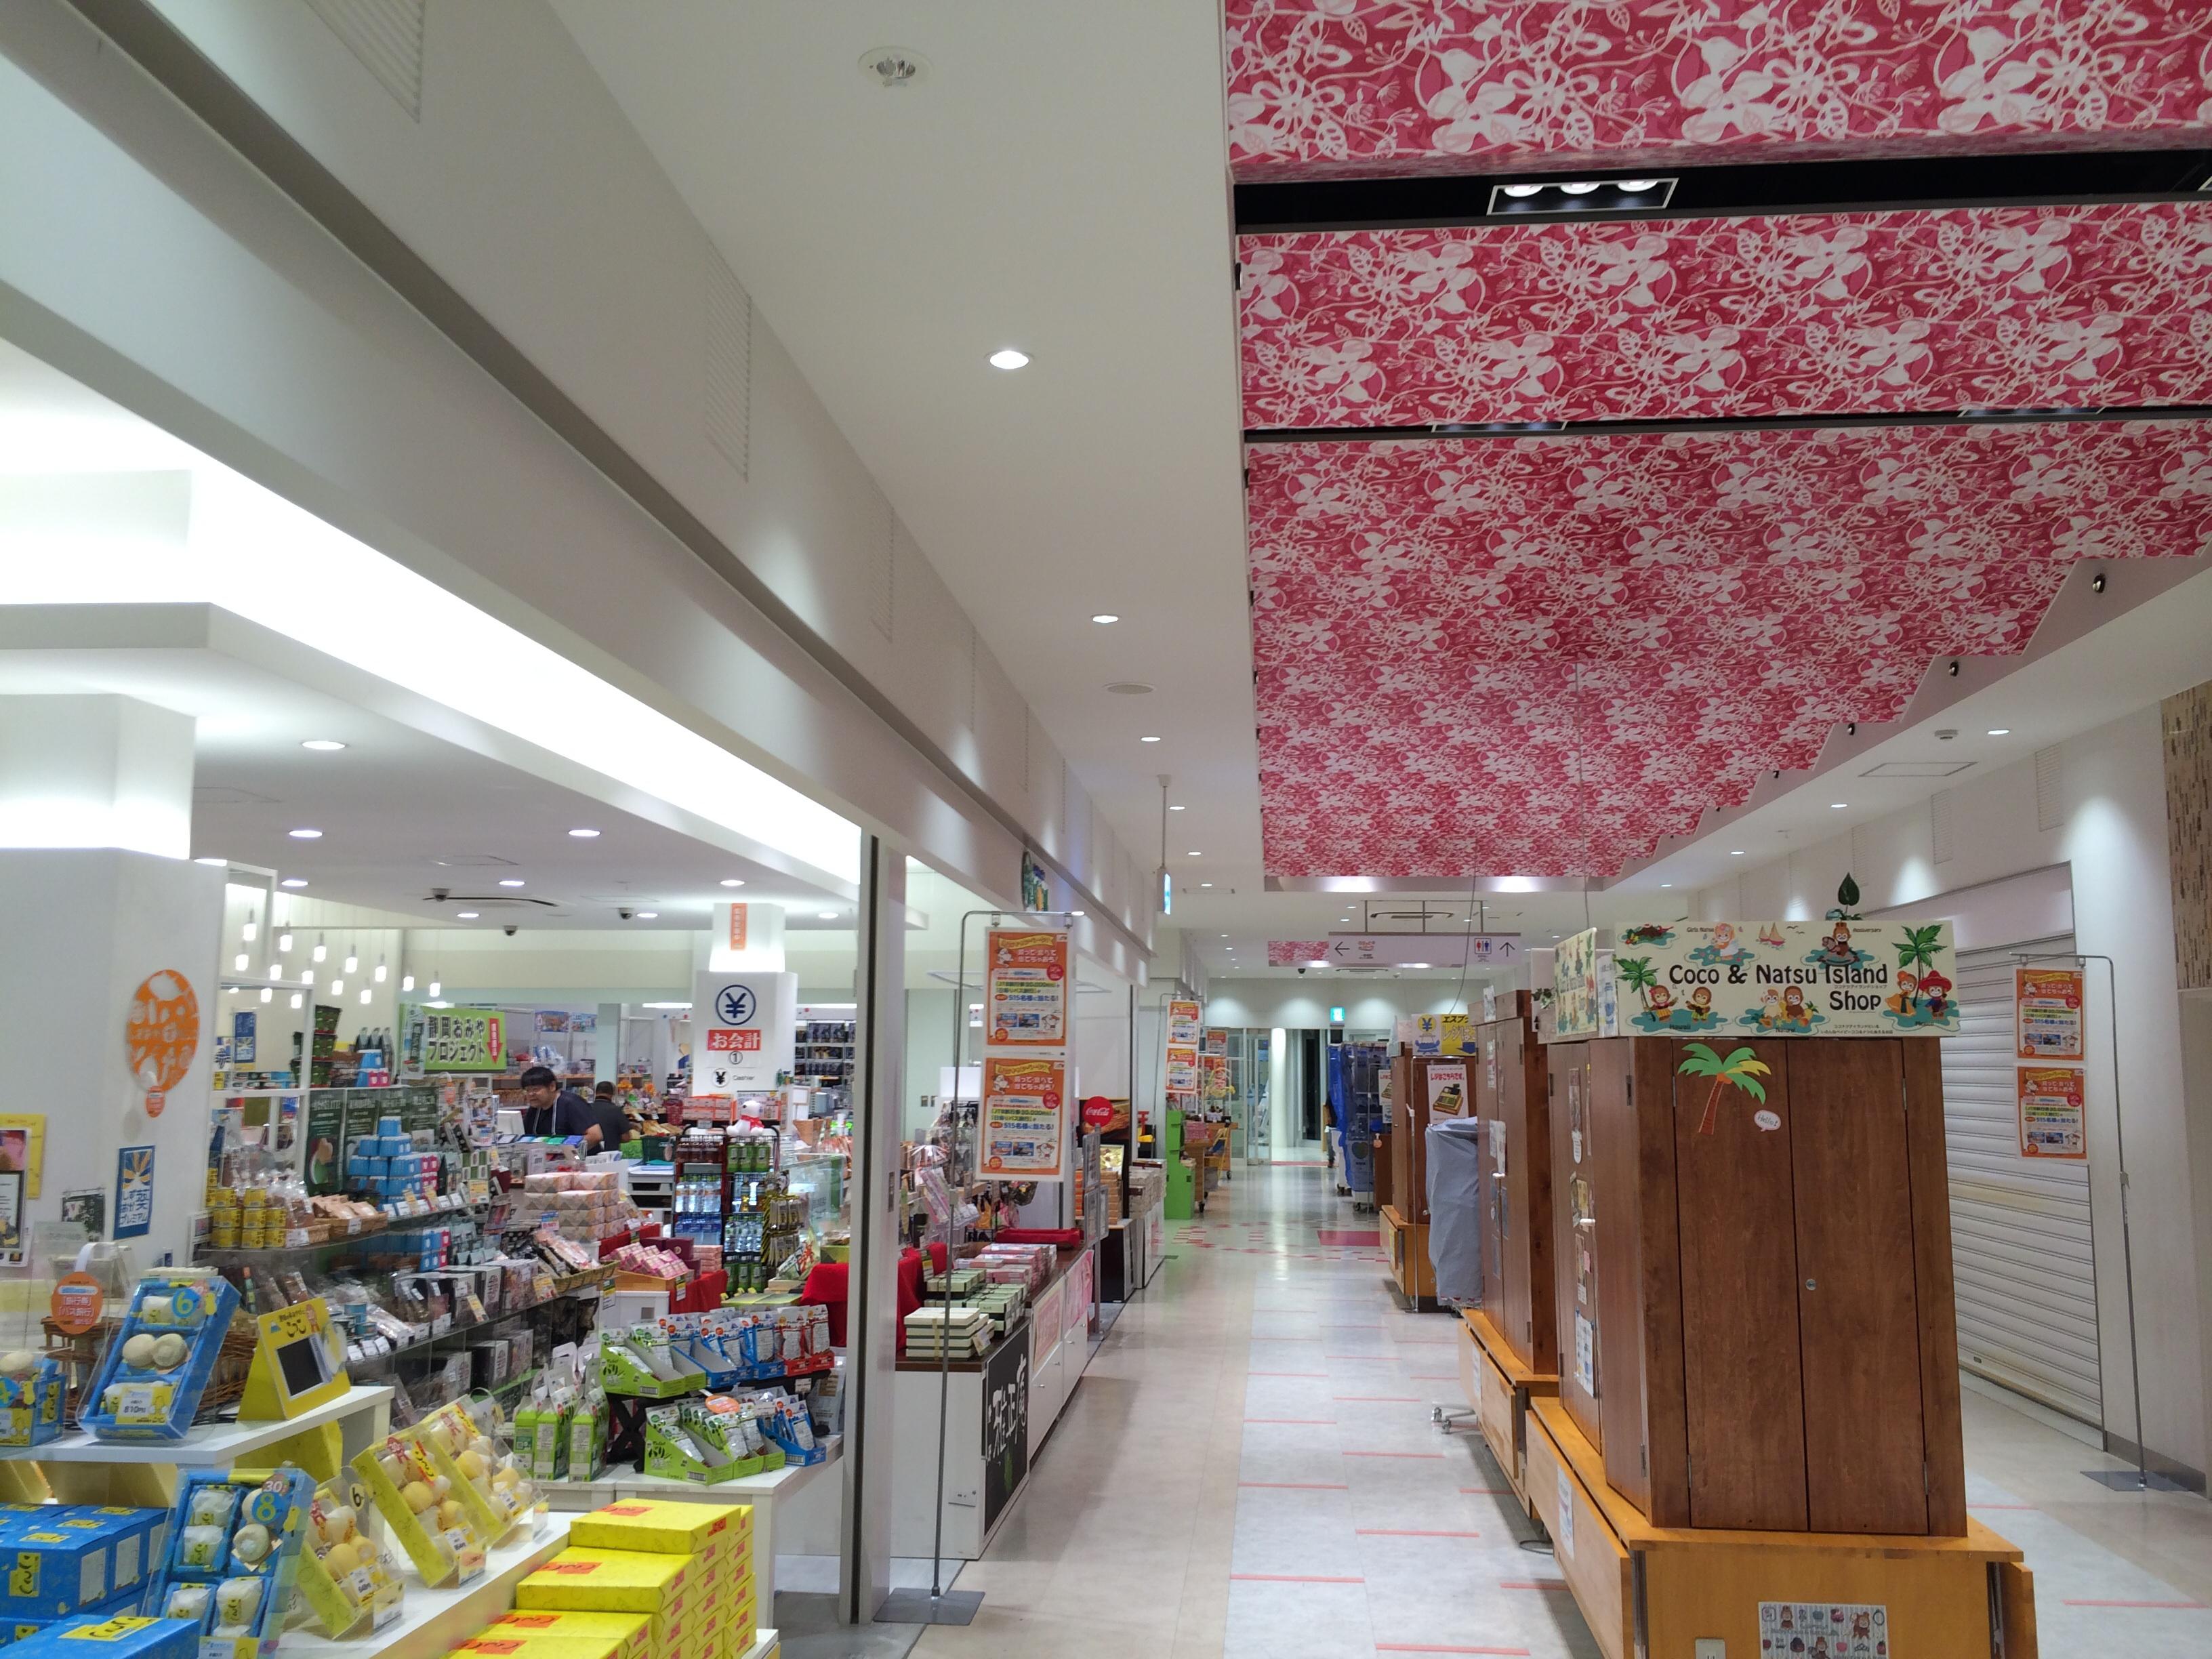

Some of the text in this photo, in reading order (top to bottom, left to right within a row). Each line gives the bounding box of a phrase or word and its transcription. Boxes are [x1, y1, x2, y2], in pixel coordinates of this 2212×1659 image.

[1669, 964, 1888, 984] Coco & Natsu Island
[1830, 990, 1881, 1010] Shop
[712, 1033, 760, 1049] お会計
[429, 1040, 485, 1063] プロジェクト
[264, 1480, 283, 1492] 30
[256, 1492, 276, 1521] 8
